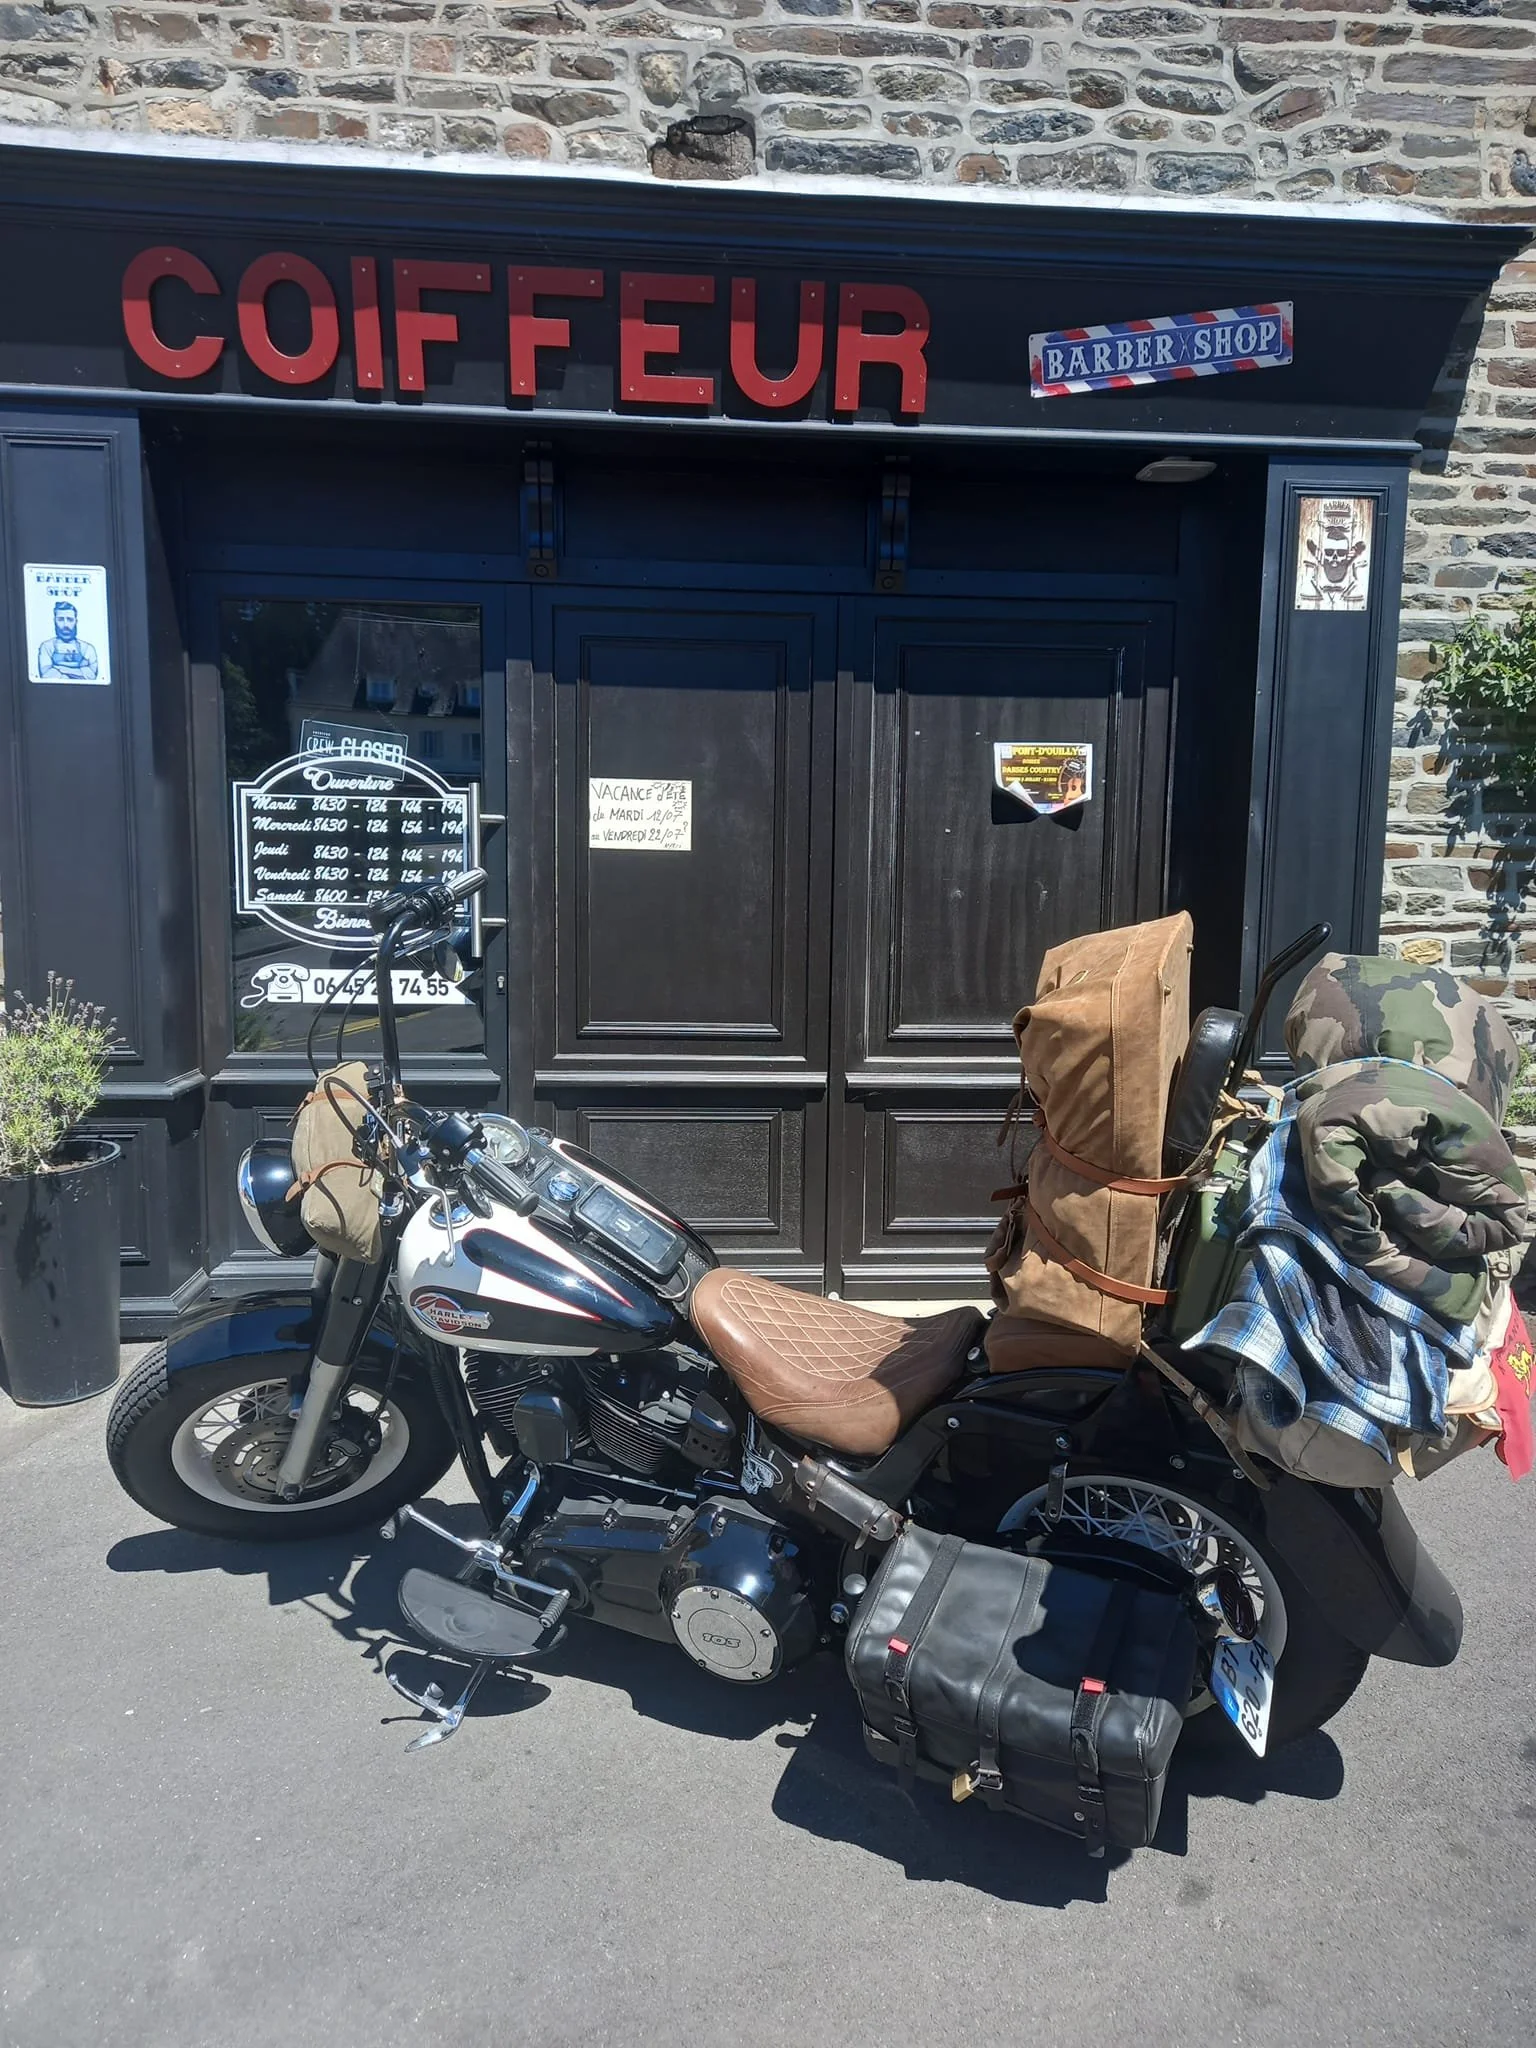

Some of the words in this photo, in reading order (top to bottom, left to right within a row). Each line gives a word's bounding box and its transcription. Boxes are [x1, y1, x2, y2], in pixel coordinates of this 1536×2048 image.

[121, 245, 931, 414] COIFFEUR
[1046, 334, 1177, 380] BARBER
[1193, 321, 1278, 361] SHOP
[36, 572, 92, 584] BARBER
[47, 586, 82, 597] SHOP
[340, 737, 404, 764] CLOSED
[302, 765, 395, 791] Ouverture
[1029, 765, 1061, 774] COUNTRY
[591, 782, 653, 801] VACANCE
[251, 797, 297, 811] Mardi
[311, 798, 347, 812] 8h30
[365, 799, 388, 813] 12h
[400, 800, 422, 813] 14h
[440, 800, 464, 814] 19h
[251, 816, 312, 832] Mercredi
[312, 817, 348, 832] 8h30
[366, 819, 388, 833] 12h
[401, 820, 422, 834] 15h
[441, 820, 464, 834] 19h
[252, 841, 289, 860] Jeudi
[313, 845, 348, 860] 8h30
[367, 847, 389, 861] 12h
[401, 848, 423, 862] 14h
[441, 849, 463, 863] 19h
[253, 866, 311, 881] Vendredi
[313, 866, 349, 881] 8h30
[367, 868, 389, 881] 12h
[400, 869, 423, 883] 15h
[255, 890, 305, 902] Samedi
[313, 907, 372, 929] Bienve
[314, 977, 337, 995] 06
[342, 978, 365, 995] 45
[399, 978, 421, 995] 74
[427, 978, 449, 996] 55
[430, 1308, 473, 1319] HARLEY
[430, 1315, 482, 1328] DAVIDSON
